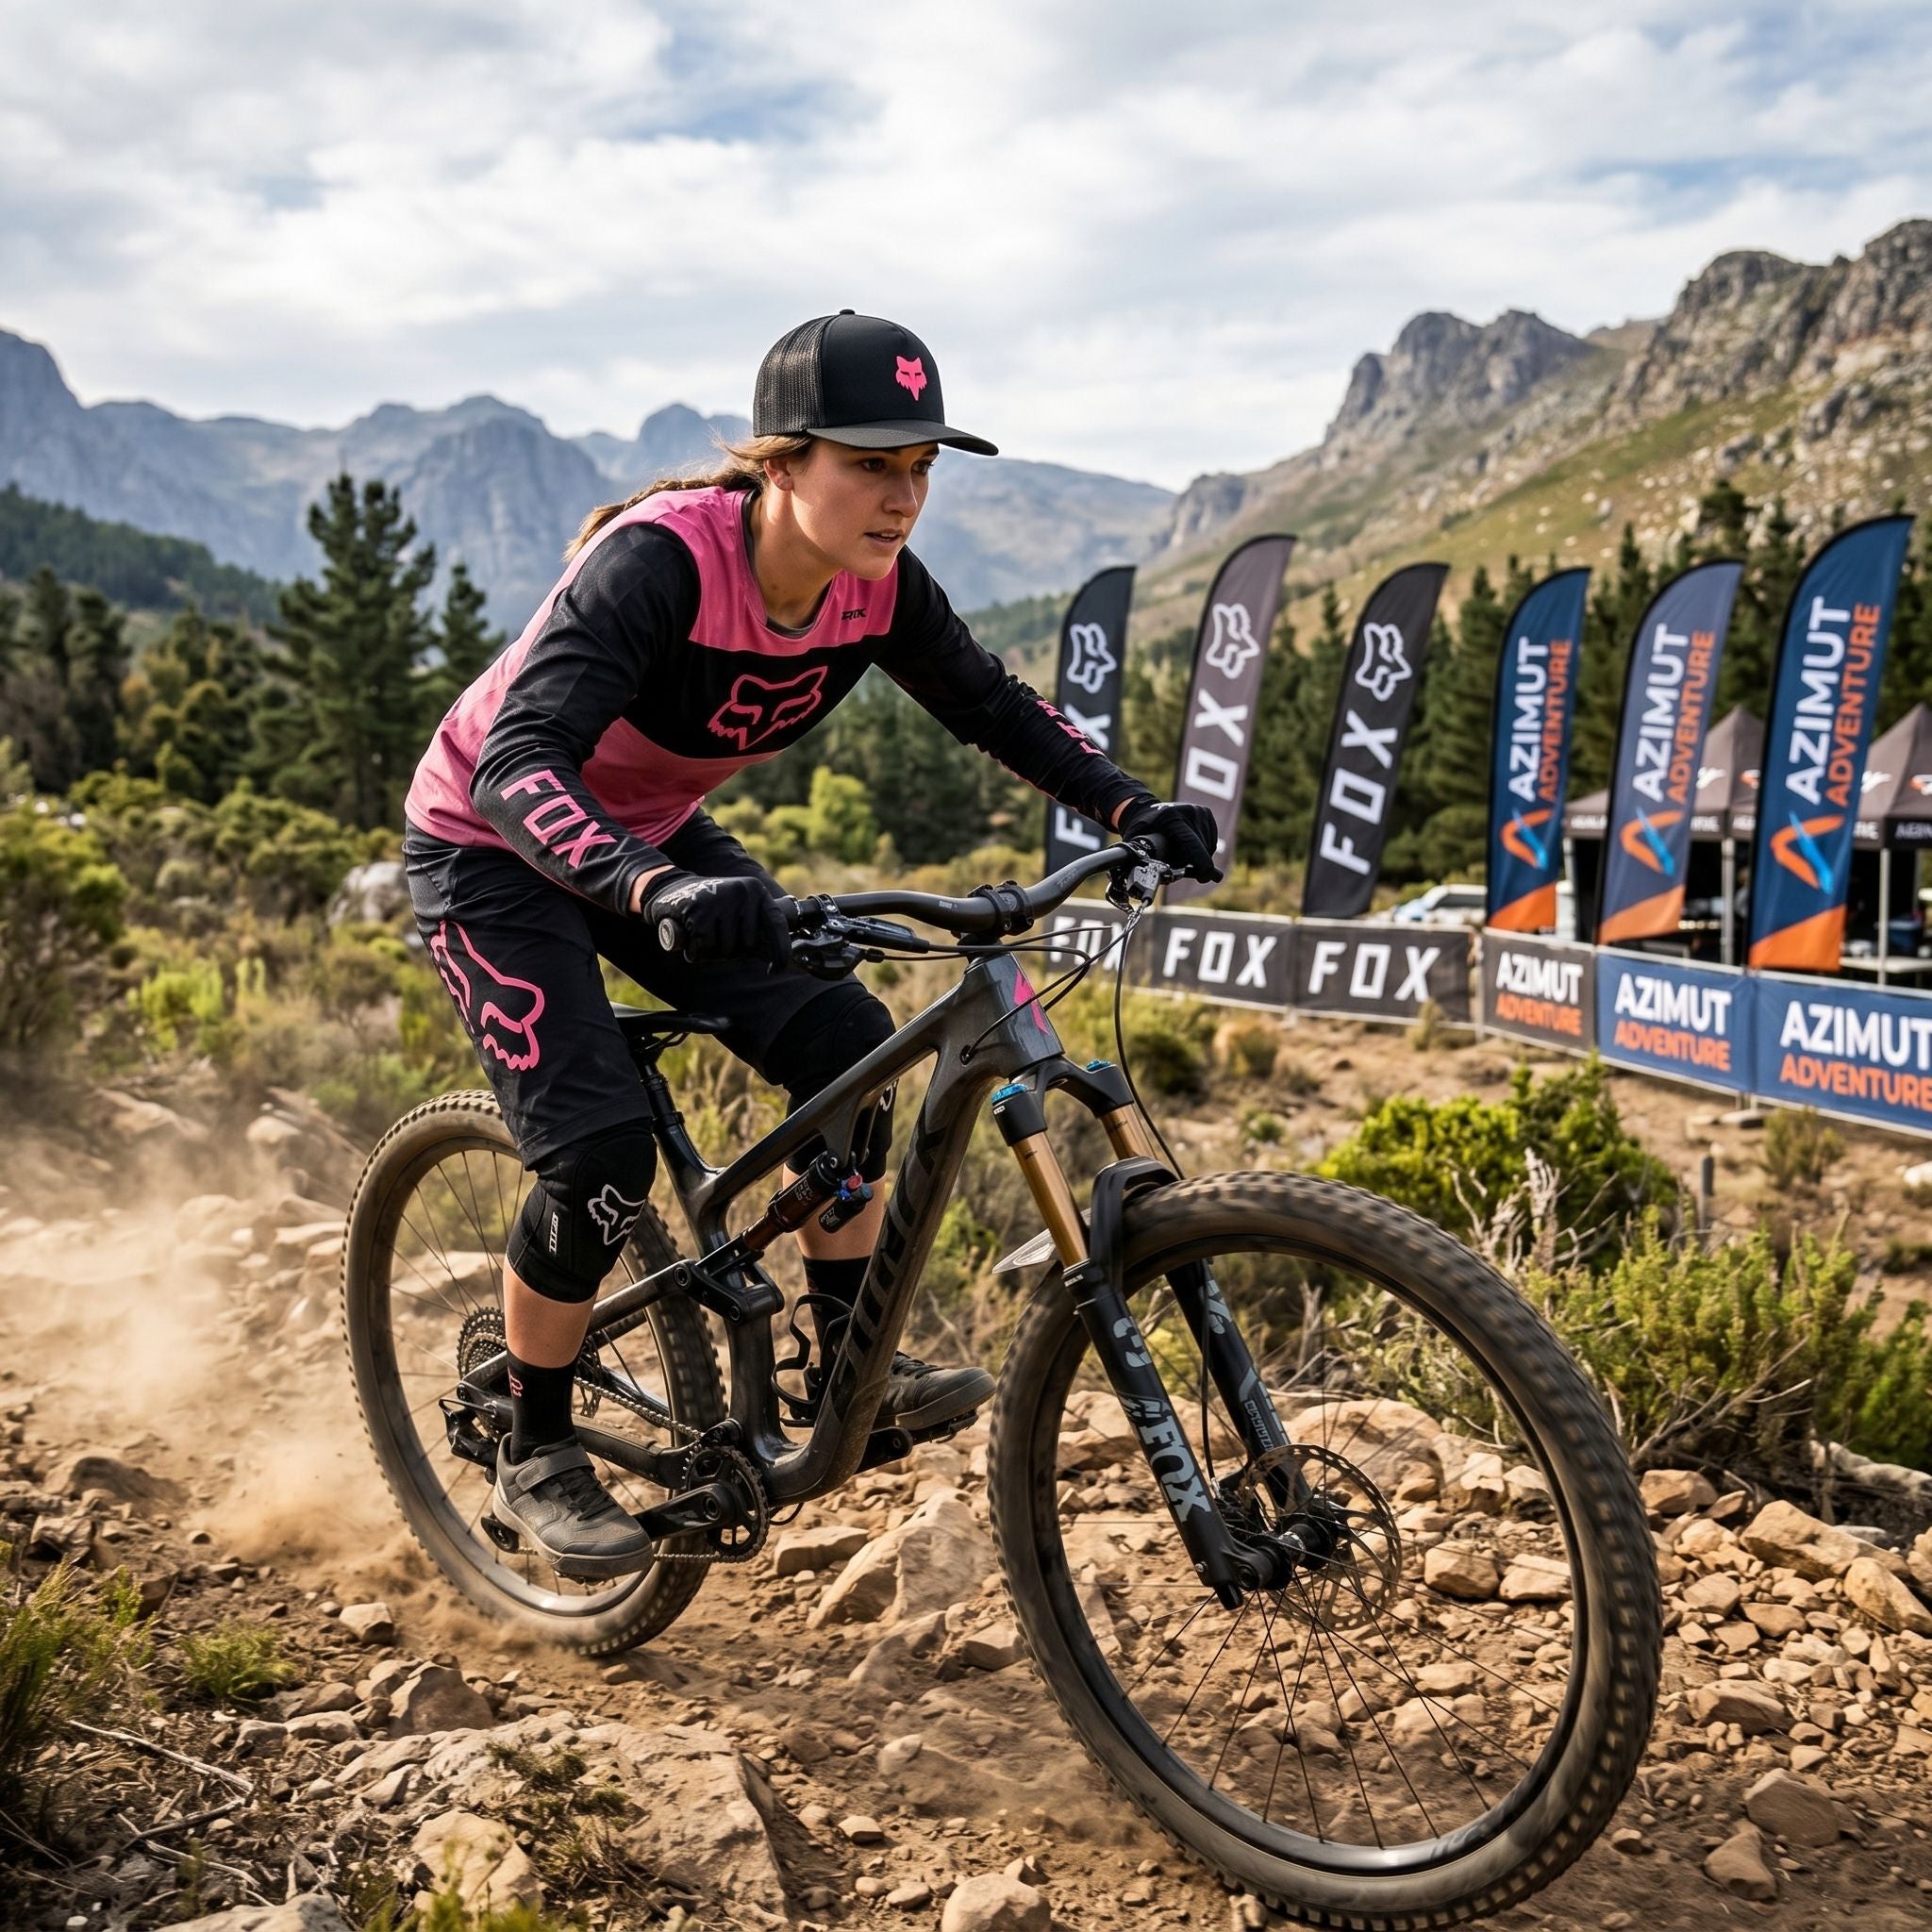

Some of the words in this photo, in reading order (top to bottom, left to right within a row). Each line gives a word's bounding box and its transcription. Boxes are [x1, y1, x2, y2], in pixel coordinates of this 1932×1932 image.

[1508, 637, 1549, 802] AZIMUT
[1536, 639, 1572, 802] ADVENTURE
[1632, 624, 1689, 802] AZIMUT
[1665, 631, 1715, 804] ADVENTURE
[1785, 596, 1850, 805] AZIMUT
[1825, 603, 1881, 807] ADVENTURE
[500, 769, 617, 869] FOX
[1054, 703, 1111, 850] FX
[1320, 709, 1398, 875] FOX
[1163, 926, 1276, 989] FOX
[1308, 941, 1441, 1003] FOX
[1495, 951, 1583, 1005] AZIMUT
[1614, 973, 1732, 1036] AZIMUT
[1495, 992, 1583, 1037] ADVENTURE
[1613, 1021, 1732, 1072] ADVENTURE
[1779, 1000, 1932, 1071] AZIMUT
[1779, 1053, 1932, 1112] ADVENTURE
[1141, 1415, 1212, 1524] FOX
